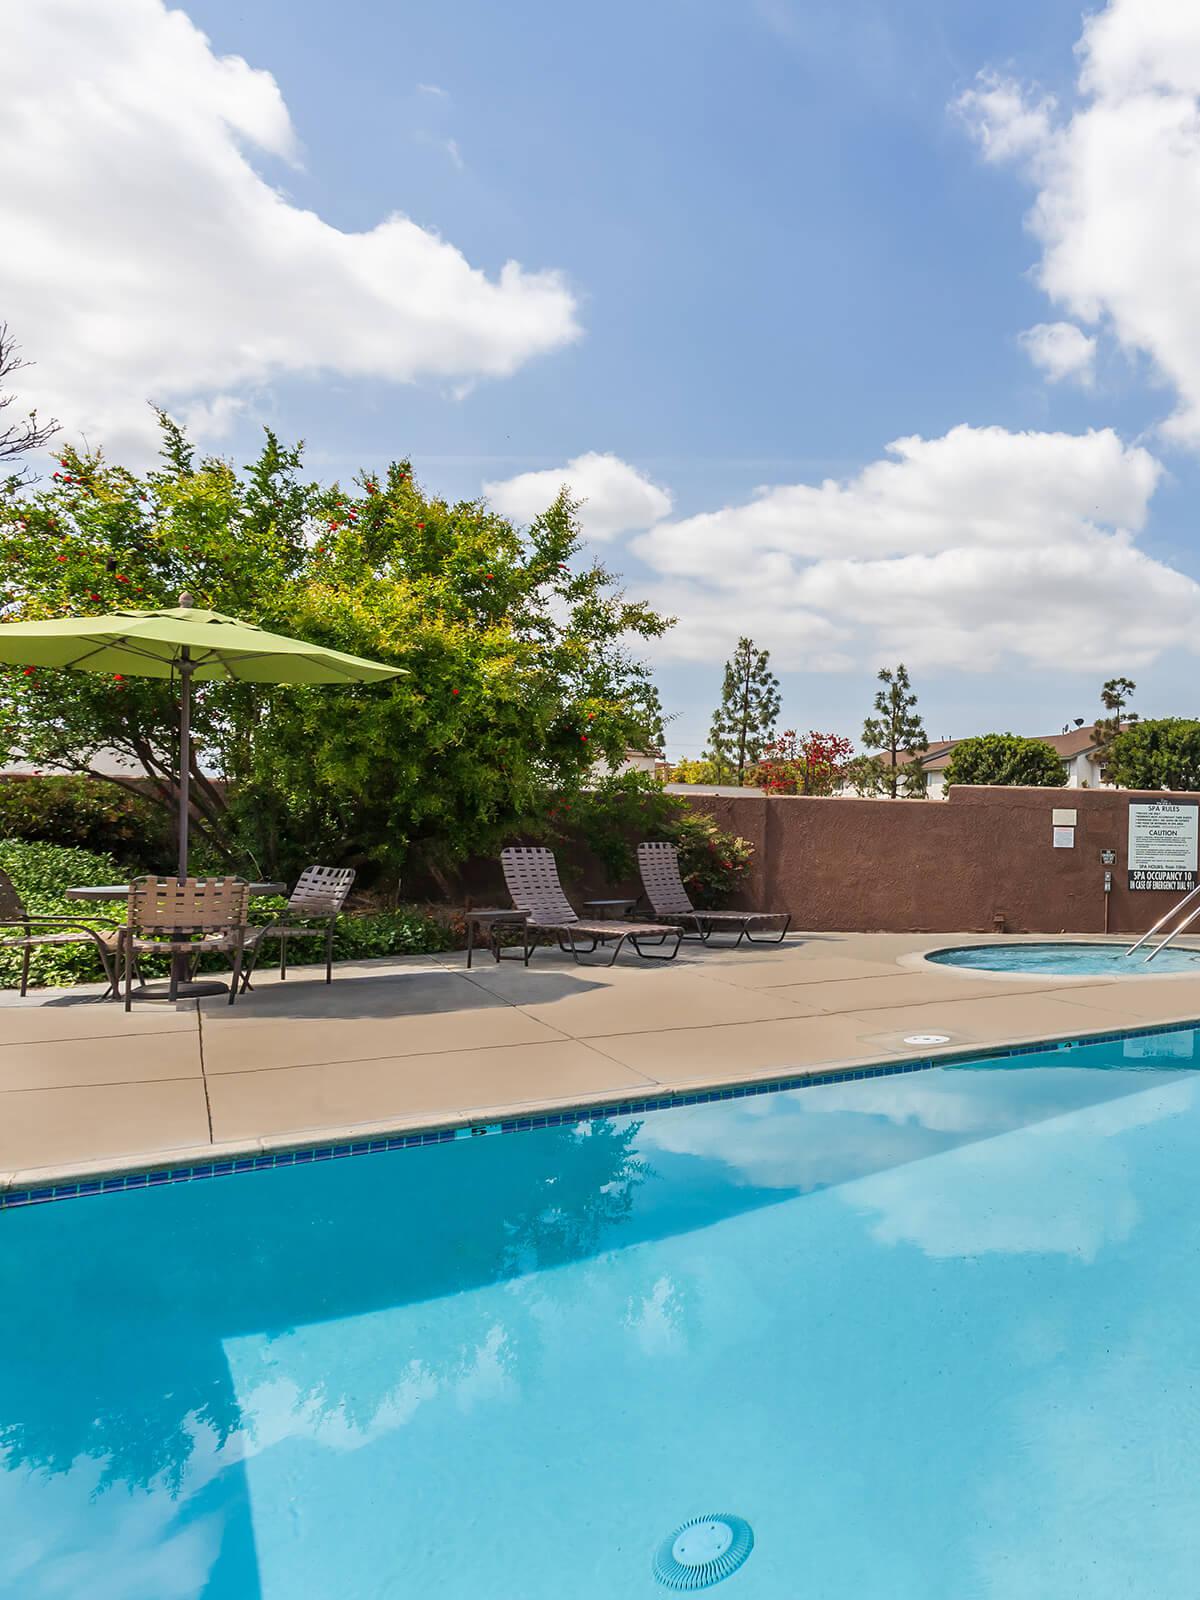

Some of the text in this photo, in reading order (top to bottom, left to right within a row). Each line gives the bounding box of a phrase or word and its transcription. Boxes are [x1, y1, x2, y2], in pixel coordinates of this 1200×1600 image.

[1133, 871, 1192, 881] SPA OCCUPANCY 10
[1130, 880, 1195, 890] IN CASE OF EMERGENCY DIAL 911
[471, 1126, 487, 1136] 5
